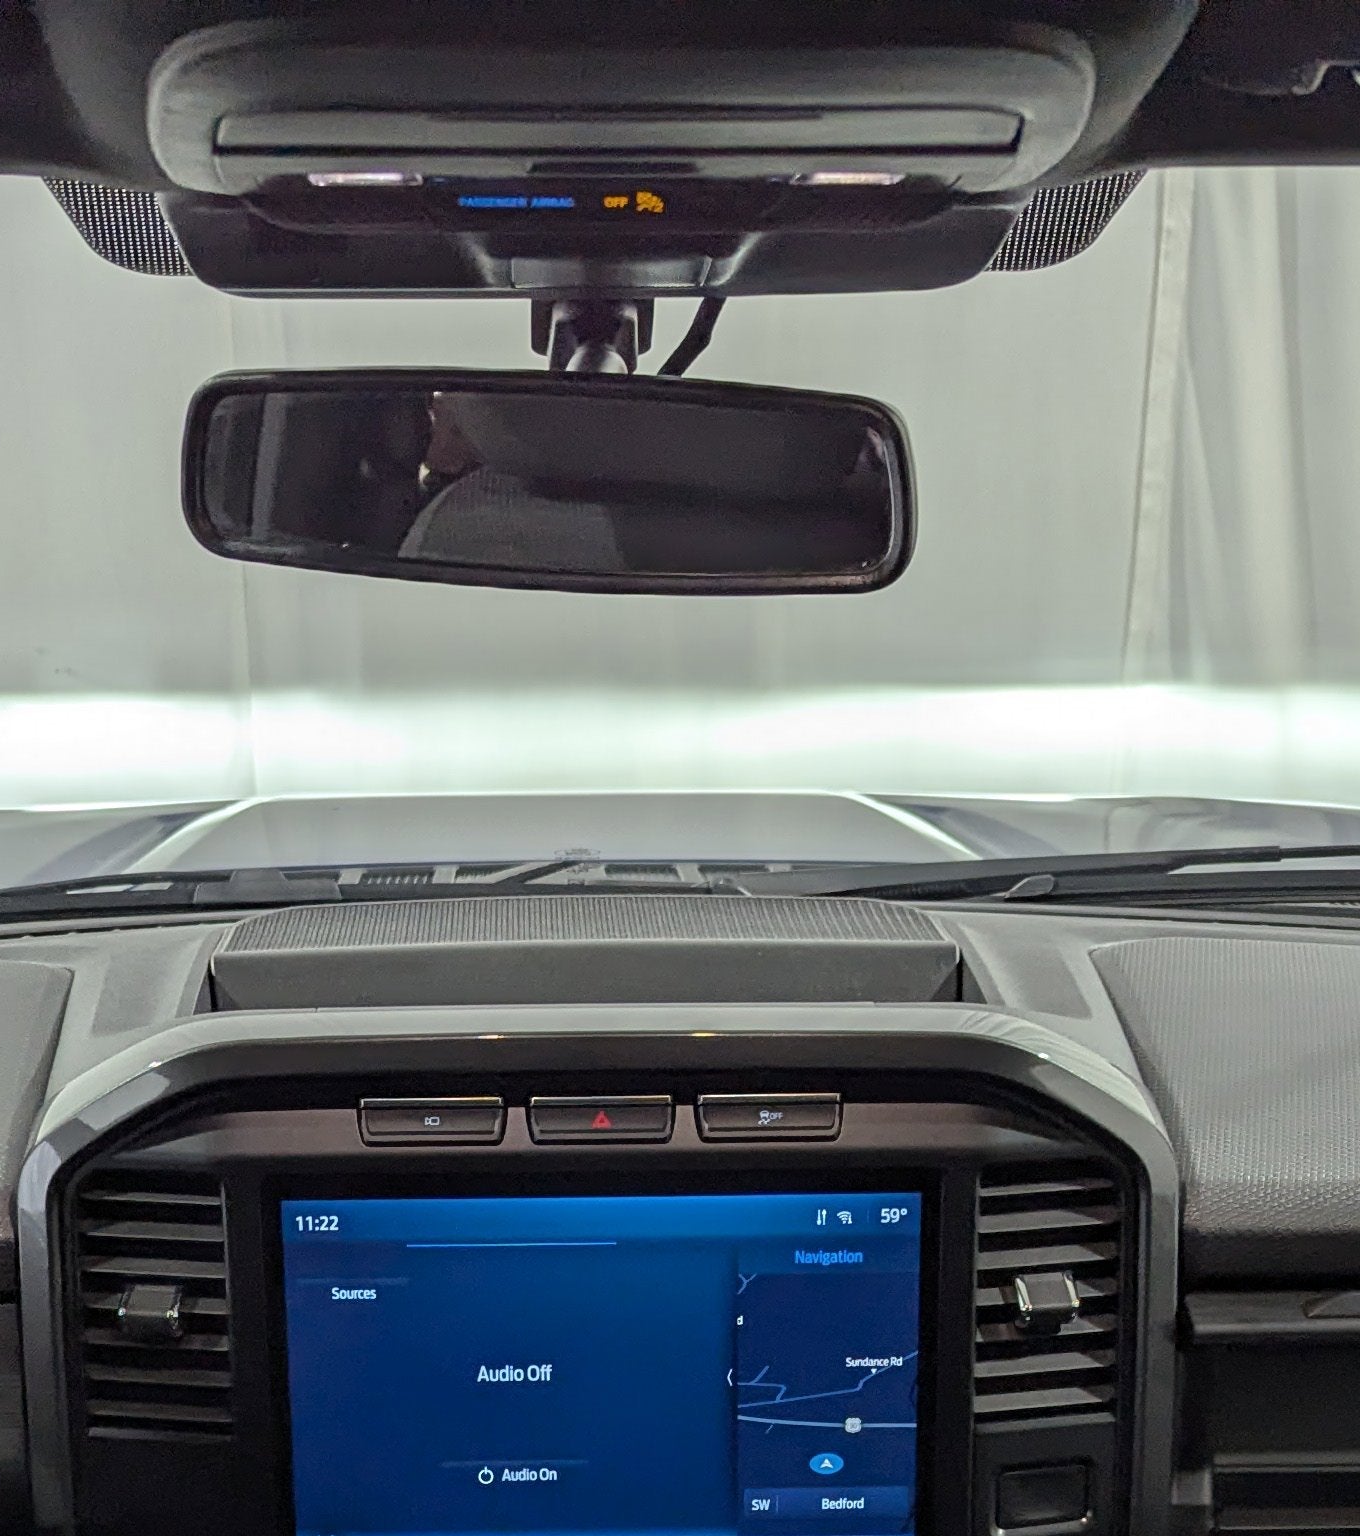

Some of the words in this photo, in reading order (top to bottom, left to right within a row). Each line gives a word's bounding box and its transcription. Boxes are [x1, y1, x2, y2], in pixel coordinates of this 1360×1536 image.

[604, 196, 629, 208] OFF
[880, 1207, 908, 1223] 59°
[296, 1215, 339, 1231] 11:22
[794, 1250, 863, 1266] Navigation
[331, 1287, 377, 1300] Sources
[845, 1356, 889, 1368] Sundance
[890, 1356, 903, 1367] Rd
[477, 1365, 524, 1382] Audio
[527, 1364, 553, 1382] Off
[501, 1468, 538, 1482] Audio
[539, 1467, 558, 1481] On
[751, 1498, 771, 1511] SW
[821, 1497, 865, 1509] Bedford
